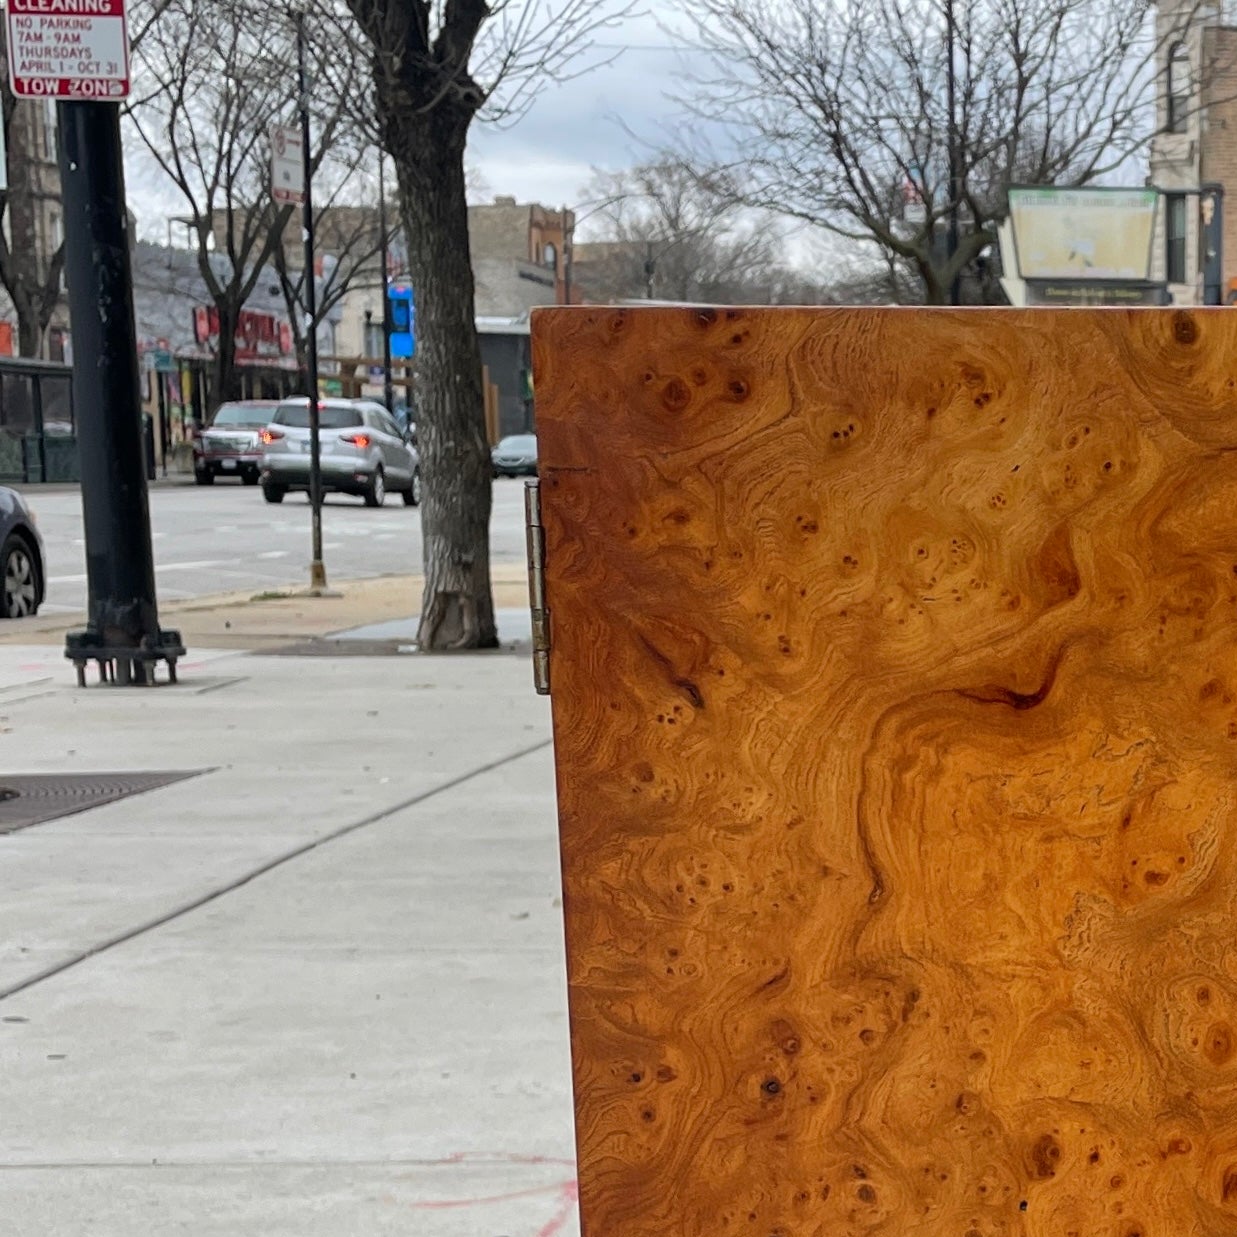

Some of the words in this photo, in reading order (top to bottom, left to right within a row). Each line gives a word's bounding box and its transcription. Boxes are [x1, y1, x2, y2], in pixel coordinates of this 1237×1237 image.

[14, 0, 112, 13] CLEANING
[16, 17, 33, 29] NO
[40, 18, 93, 31] PARKING
[18, 31, 43, 42] 7AM
[54, 32, 82, 44] 9AM
[18, 45, 93, 60] THURSDAYS
[20, 60, 56, 74] APRIL
[77, 61, 101, 74] OCT
[106, 62, 118, 75] 31
[21, 78, 60, 95] TOW
[68, 79, 124, 96] ZON
